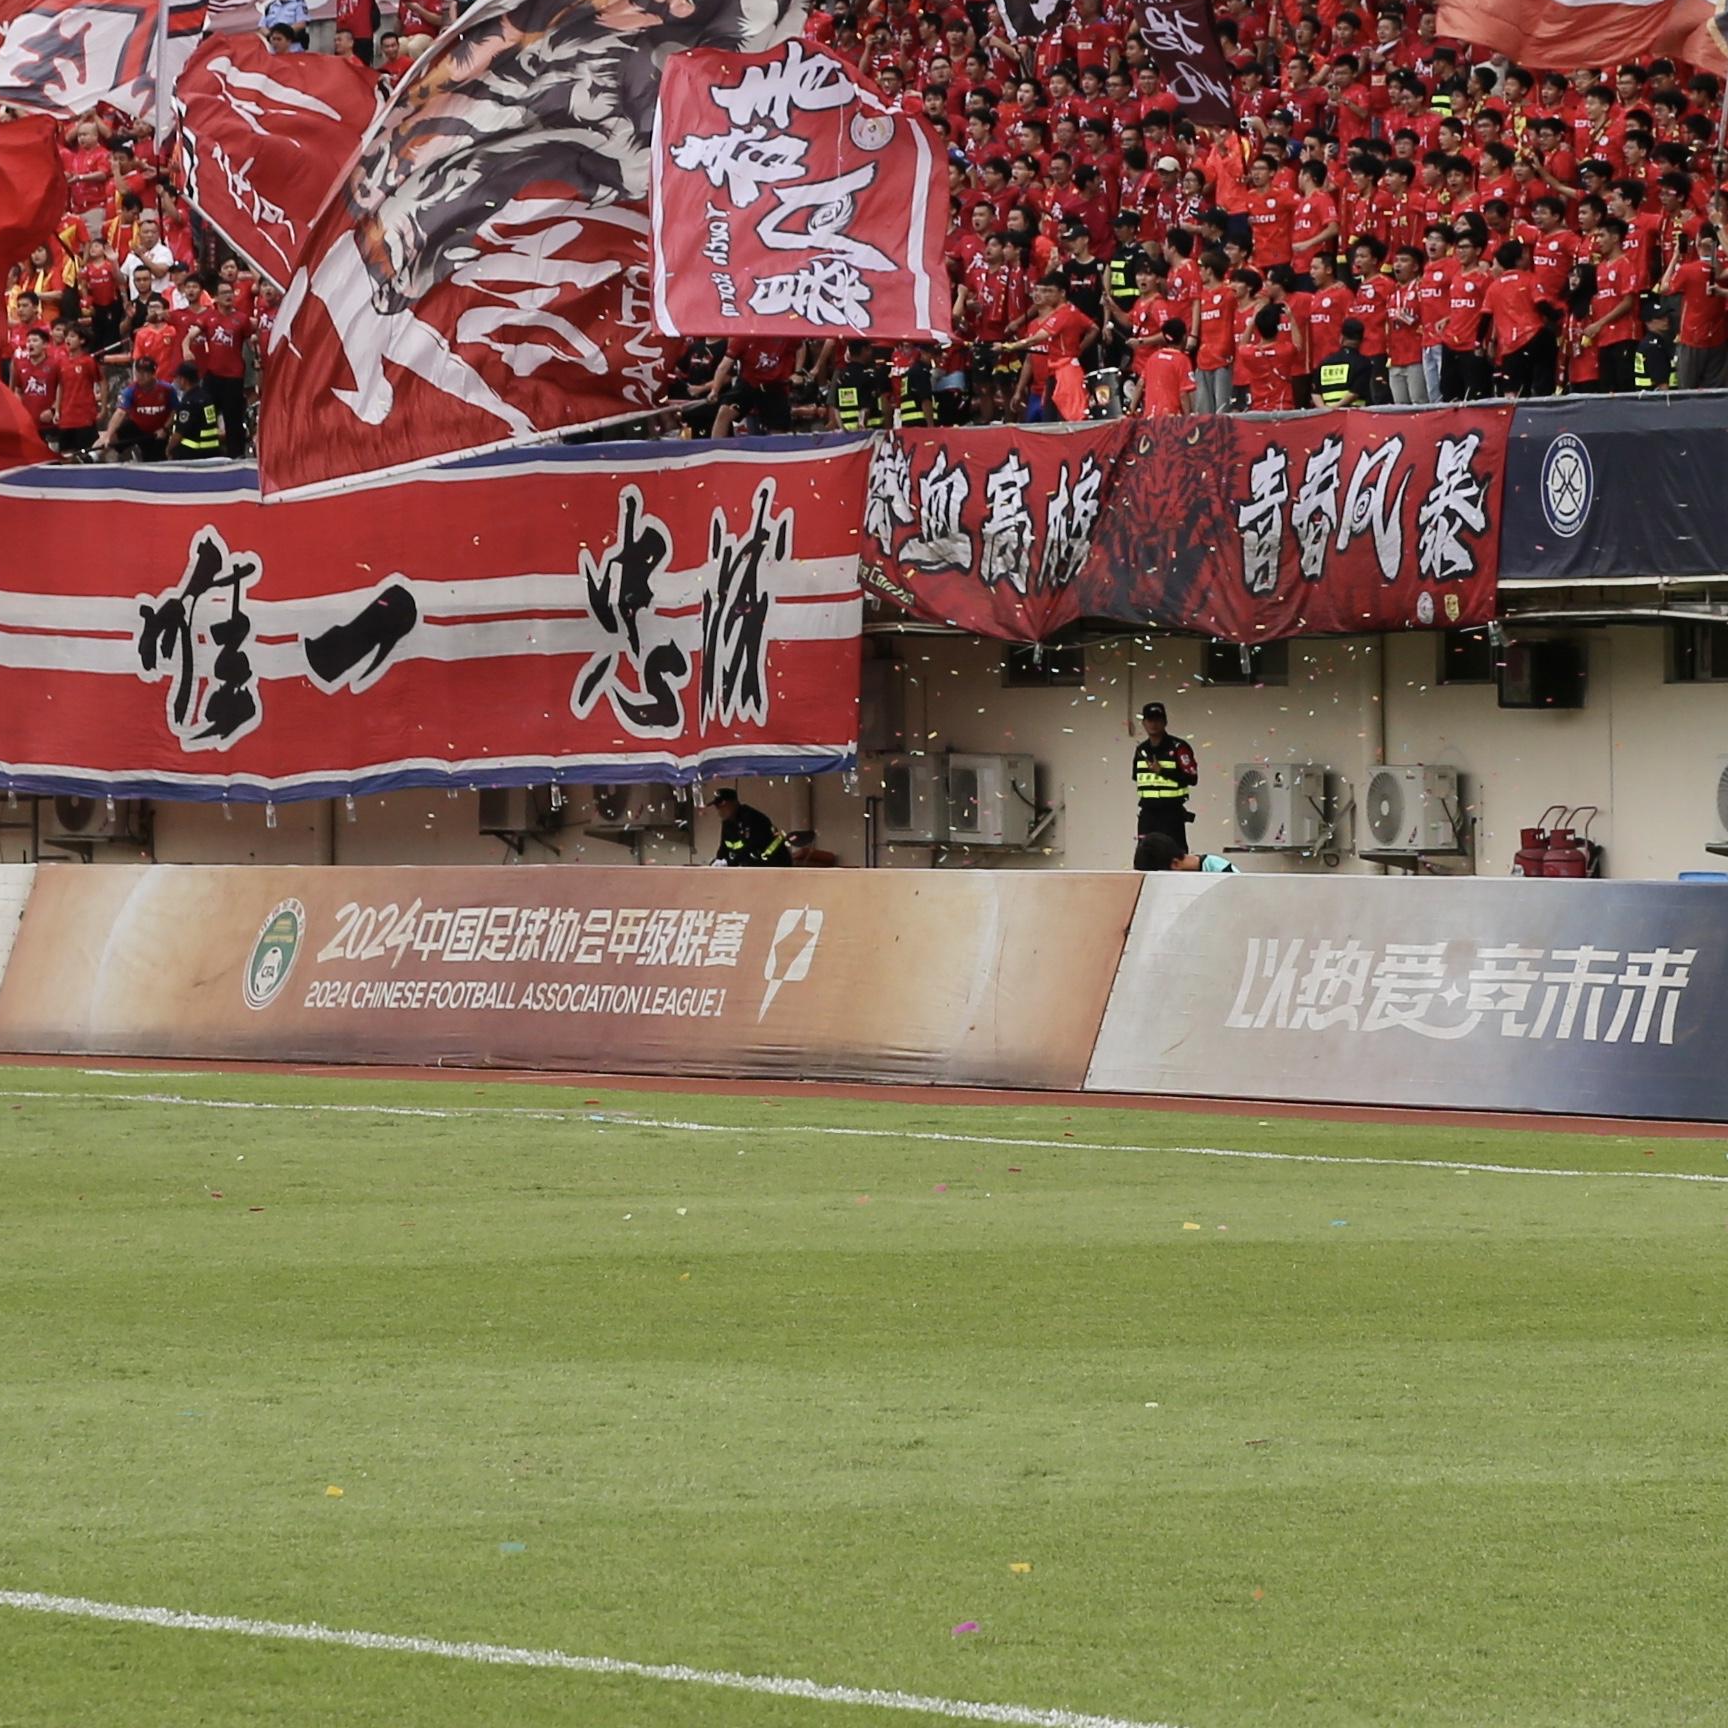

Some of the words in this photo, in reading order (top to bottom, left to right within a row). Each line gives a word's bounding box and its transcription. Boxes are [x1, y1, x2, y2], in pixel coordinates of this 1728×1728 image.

[303, 980, 350, 1009] 2024
[351, 981, 426, 1010] CHINESE
[426, 982, 517, 1012] FOOTBALL
[518, 983, 641, 1015] ASSOCIATION
[641, 987, 714, 1018] LEAGUE
